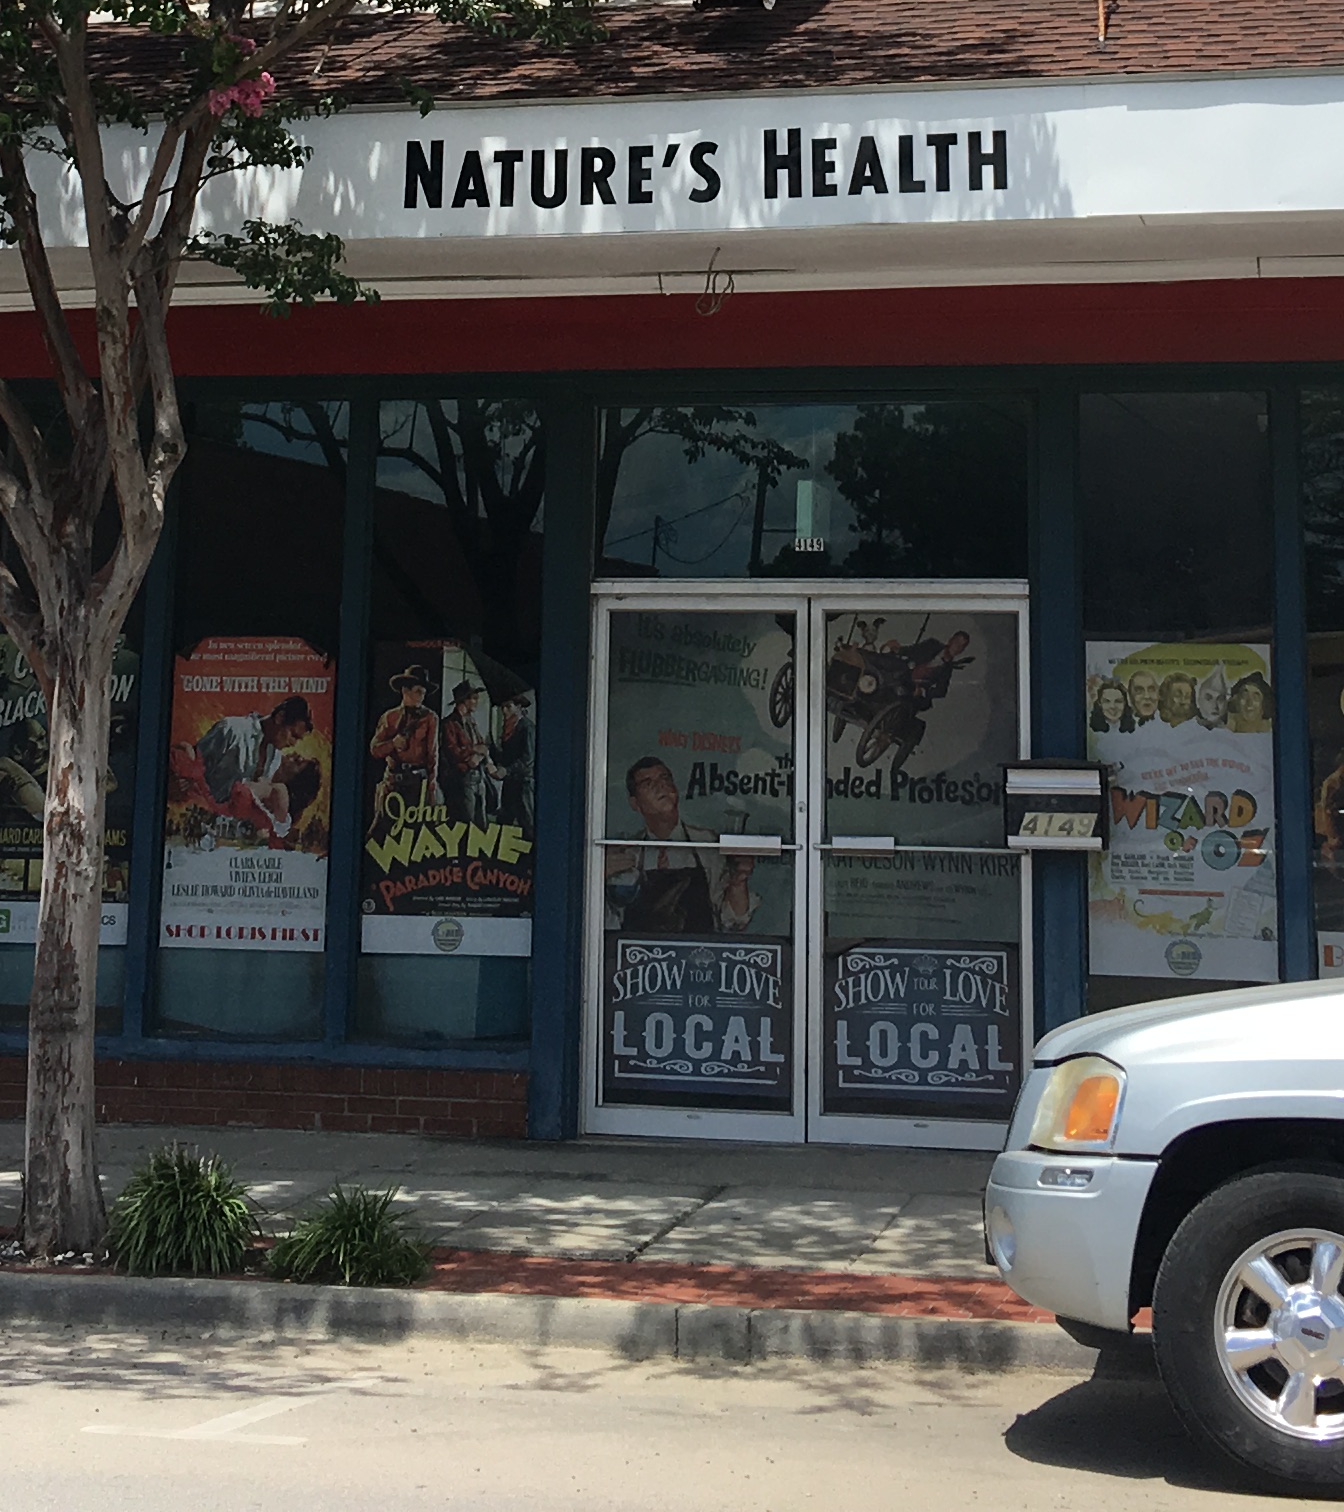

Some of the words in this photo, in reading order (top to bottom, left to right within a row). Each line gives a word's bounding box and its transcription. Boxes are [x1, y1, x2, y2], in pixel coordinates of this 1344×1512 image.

[403, 139, 721, 209] NATURE'S
[763, 127, 1008, 199] HEALTH
[796, 538, 822, 550] 4149
[671, 623, 757, 658] absolutely
[223, 676, 259, 692] WITH
[260, 676, 289, 693] THE
[617, 645, 769, 690] FLUBBERGASTING!
[385, 779, 449, 836] John
[1111, 786, 1258, 831] WIZARD
[1022, 814, 1094, 837] 4149
[229, 857, 255, 869] CLARK
[257, 857, 282, 869] GABLE
[365, 821, 533, 874] WAYNE
[923, 852, 972, 874] WYNN
[1201, 828, 1270, 871] OZ
[171, 884, 199, 897] LESLIE
[201, 884, 236, 897] HOWARD
[229, 870, 256, 883] VIVIEN
[258, 871, 282, 883] LEIGH
[165, 924, 212, 938] SHOP
[215, 925, 267, 940] LORIS
[271, 927, 321, 941] FIRST
[612, 959, 687, 1003] SHOW
[689, 969, 714, 983] YOUR
[718, 961, 782, 1009] LOVE
[688, 994, 711, 1007] FOR
[834, 967, 909, 1012] SHOW
[912, 977, 939, 990] YOUR
[943, 968, 1009, 1017] LOVE
[912, 1002, 936, 1015] FOR
[610, 1010, 785, 1063] LOCAL
[833, 1020, 1014, 1071] LOCAL
